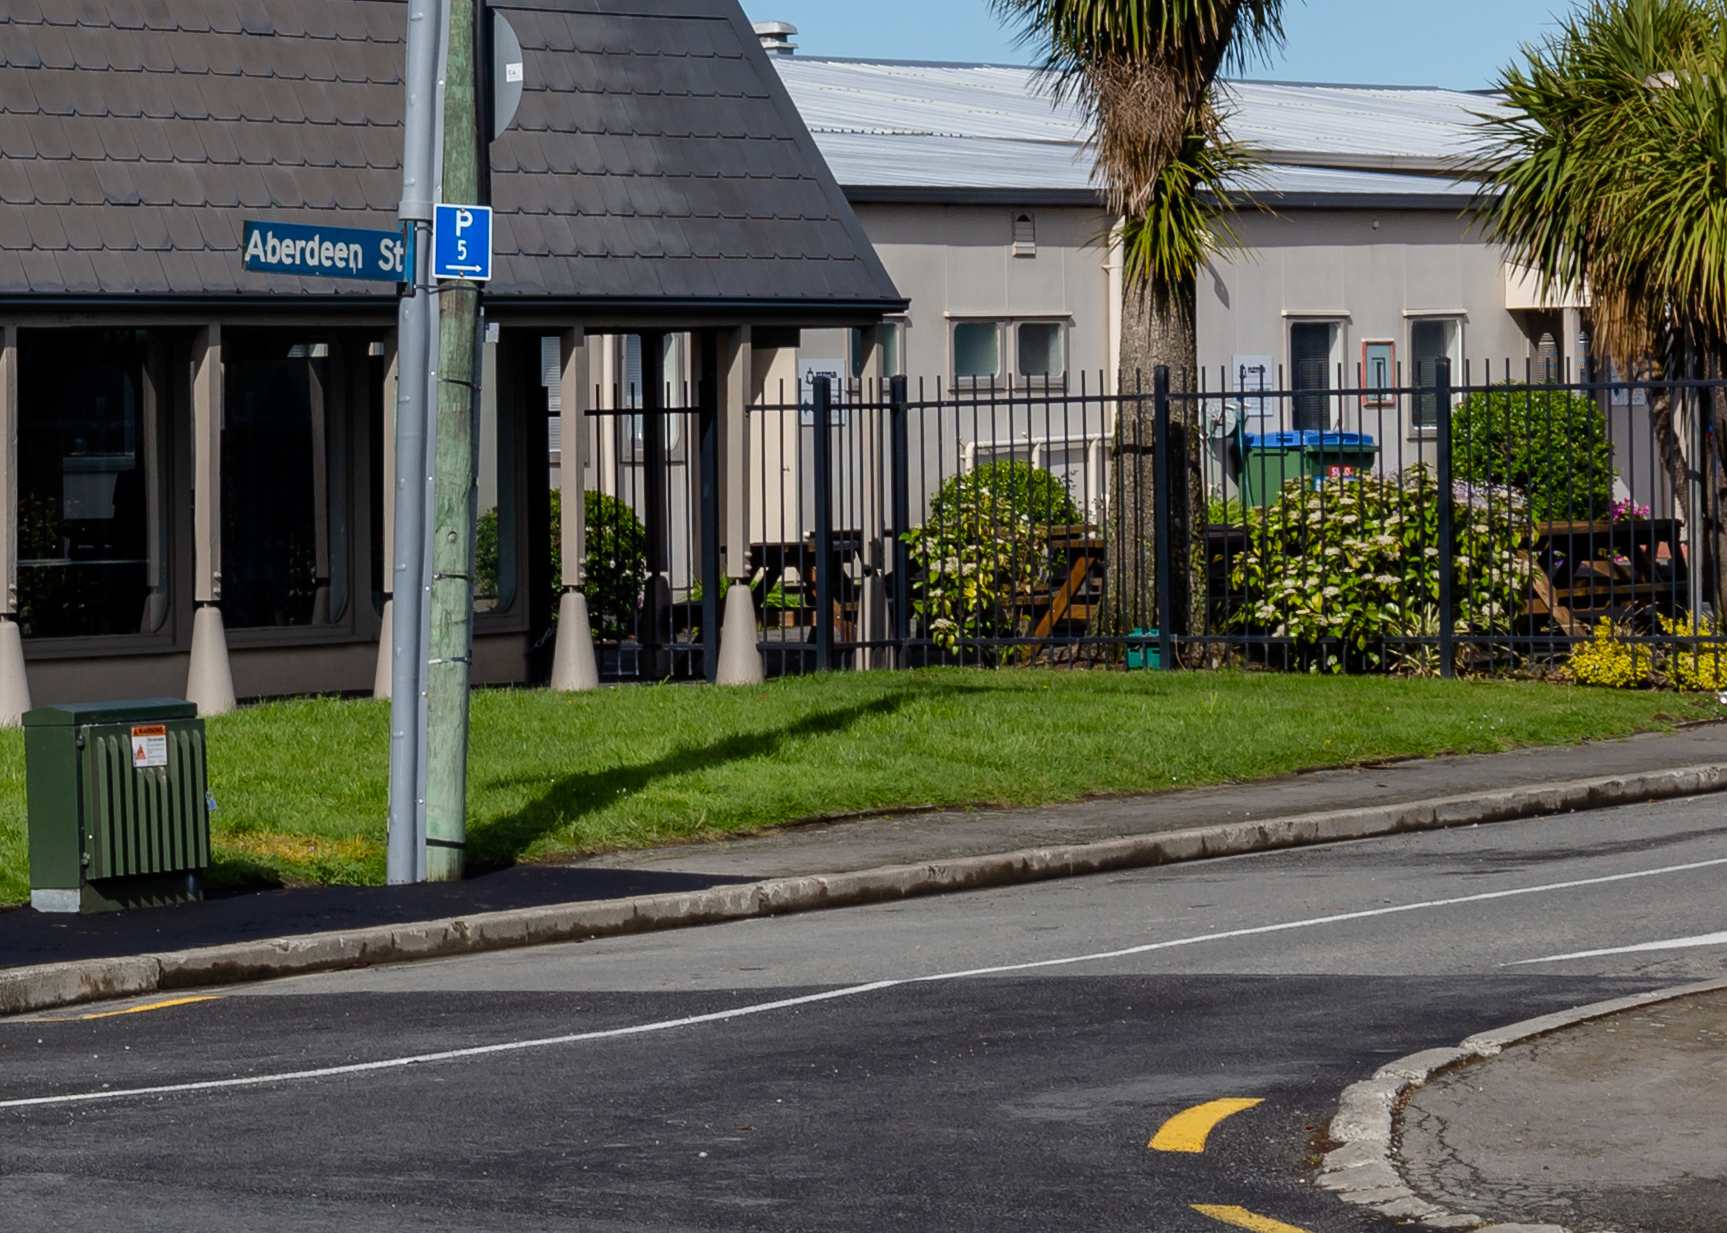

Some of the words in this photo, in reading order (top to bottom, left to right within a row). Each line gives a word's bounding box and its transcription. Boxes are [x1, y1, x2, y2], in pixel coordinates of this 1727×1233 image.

[456, 209, 473, 237] P
[245, 229, 363, 270] Aberdeen
[378, 238, 404, 273] St
[457, 239, 467, 261] 5
